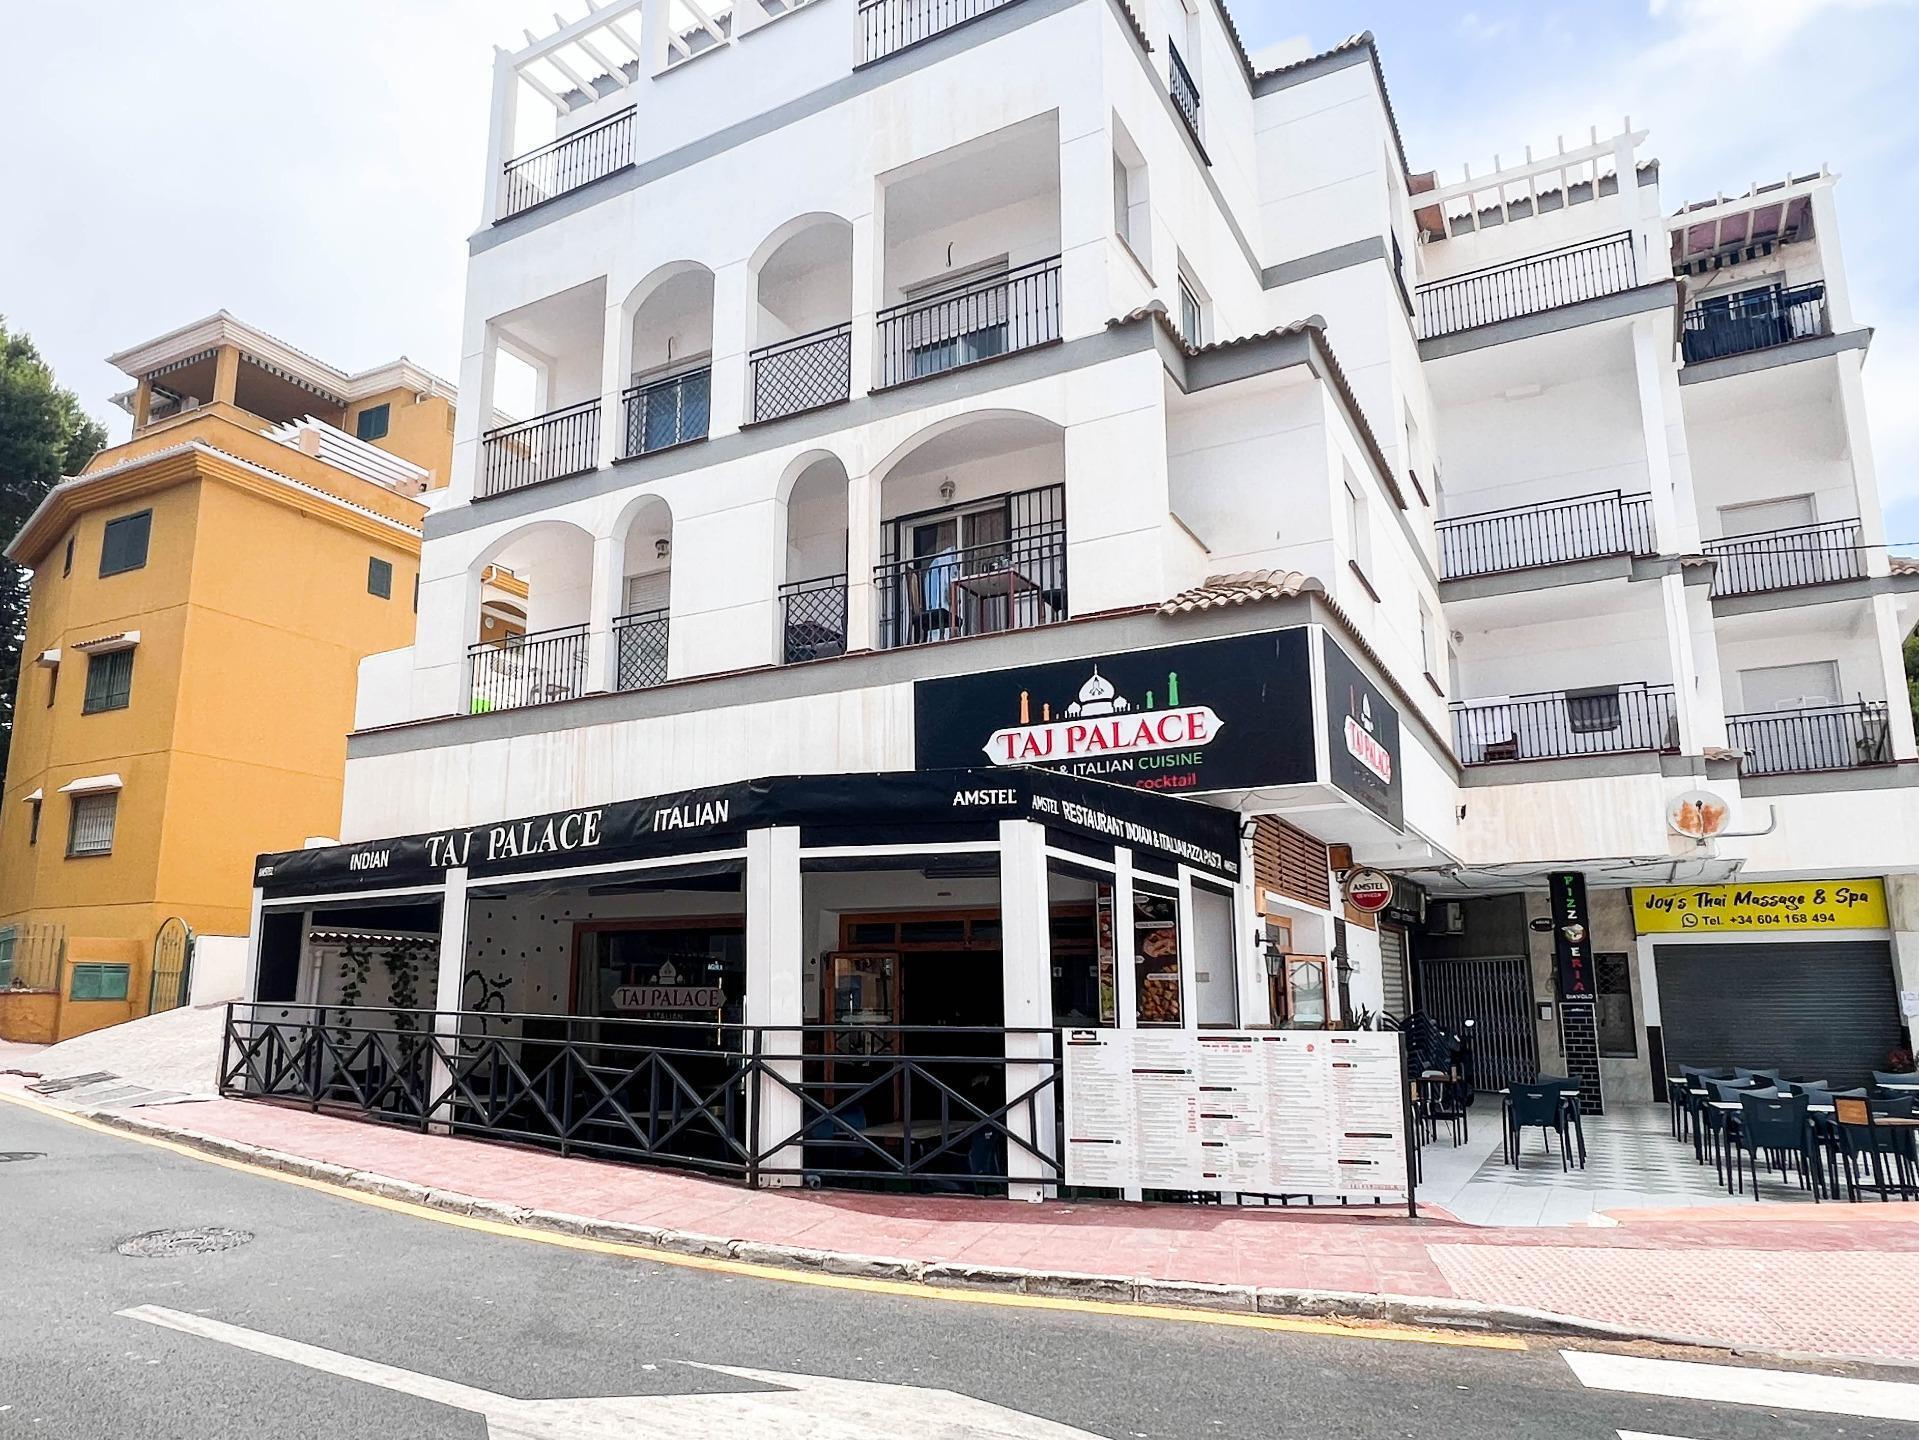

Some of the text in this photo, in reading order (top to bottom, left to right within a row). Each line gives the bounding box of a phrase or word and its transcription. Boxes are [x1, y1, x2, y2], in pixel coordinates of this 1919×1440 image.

[997, 712, 1208, 760] TAJ PALACE
[1074, 758, 1134, 776] ITALIAN
[1138, 752, 1203, 770] CUISINE
[1135, 773, 1197, 789] cocktail
[952, 788, 1018, 806] AMSTEL
[349, 849, 390, 871] INDIAN
[424, 830, 472, 868] TAJ
[487, 809, 602, 861] PALACE
[652, 799, 729, 832] ITALIAN
[1031, 794, 1060, 815] AMSTEL
[1061, 800, 1125, 837] RESTAURANT
[1125, 821, 1153, 846] INDIAN
[1153, 830, 1160, 848] &
[1159, 832, 1187, 858] ITALIAN
[1353, 882, 1384, 891] AMSTEL
[1645, 887, 1868, 912] Joy's Thai Massage & Spa
[1730, 915, 1752, 925] +34
[1757, 914, 1780, 924] 604
[1785, 913, 1807, 923] 168
[1812, 912, 1835, 923] 494
[618, 989, 719, 1007] TAJ PALACE
